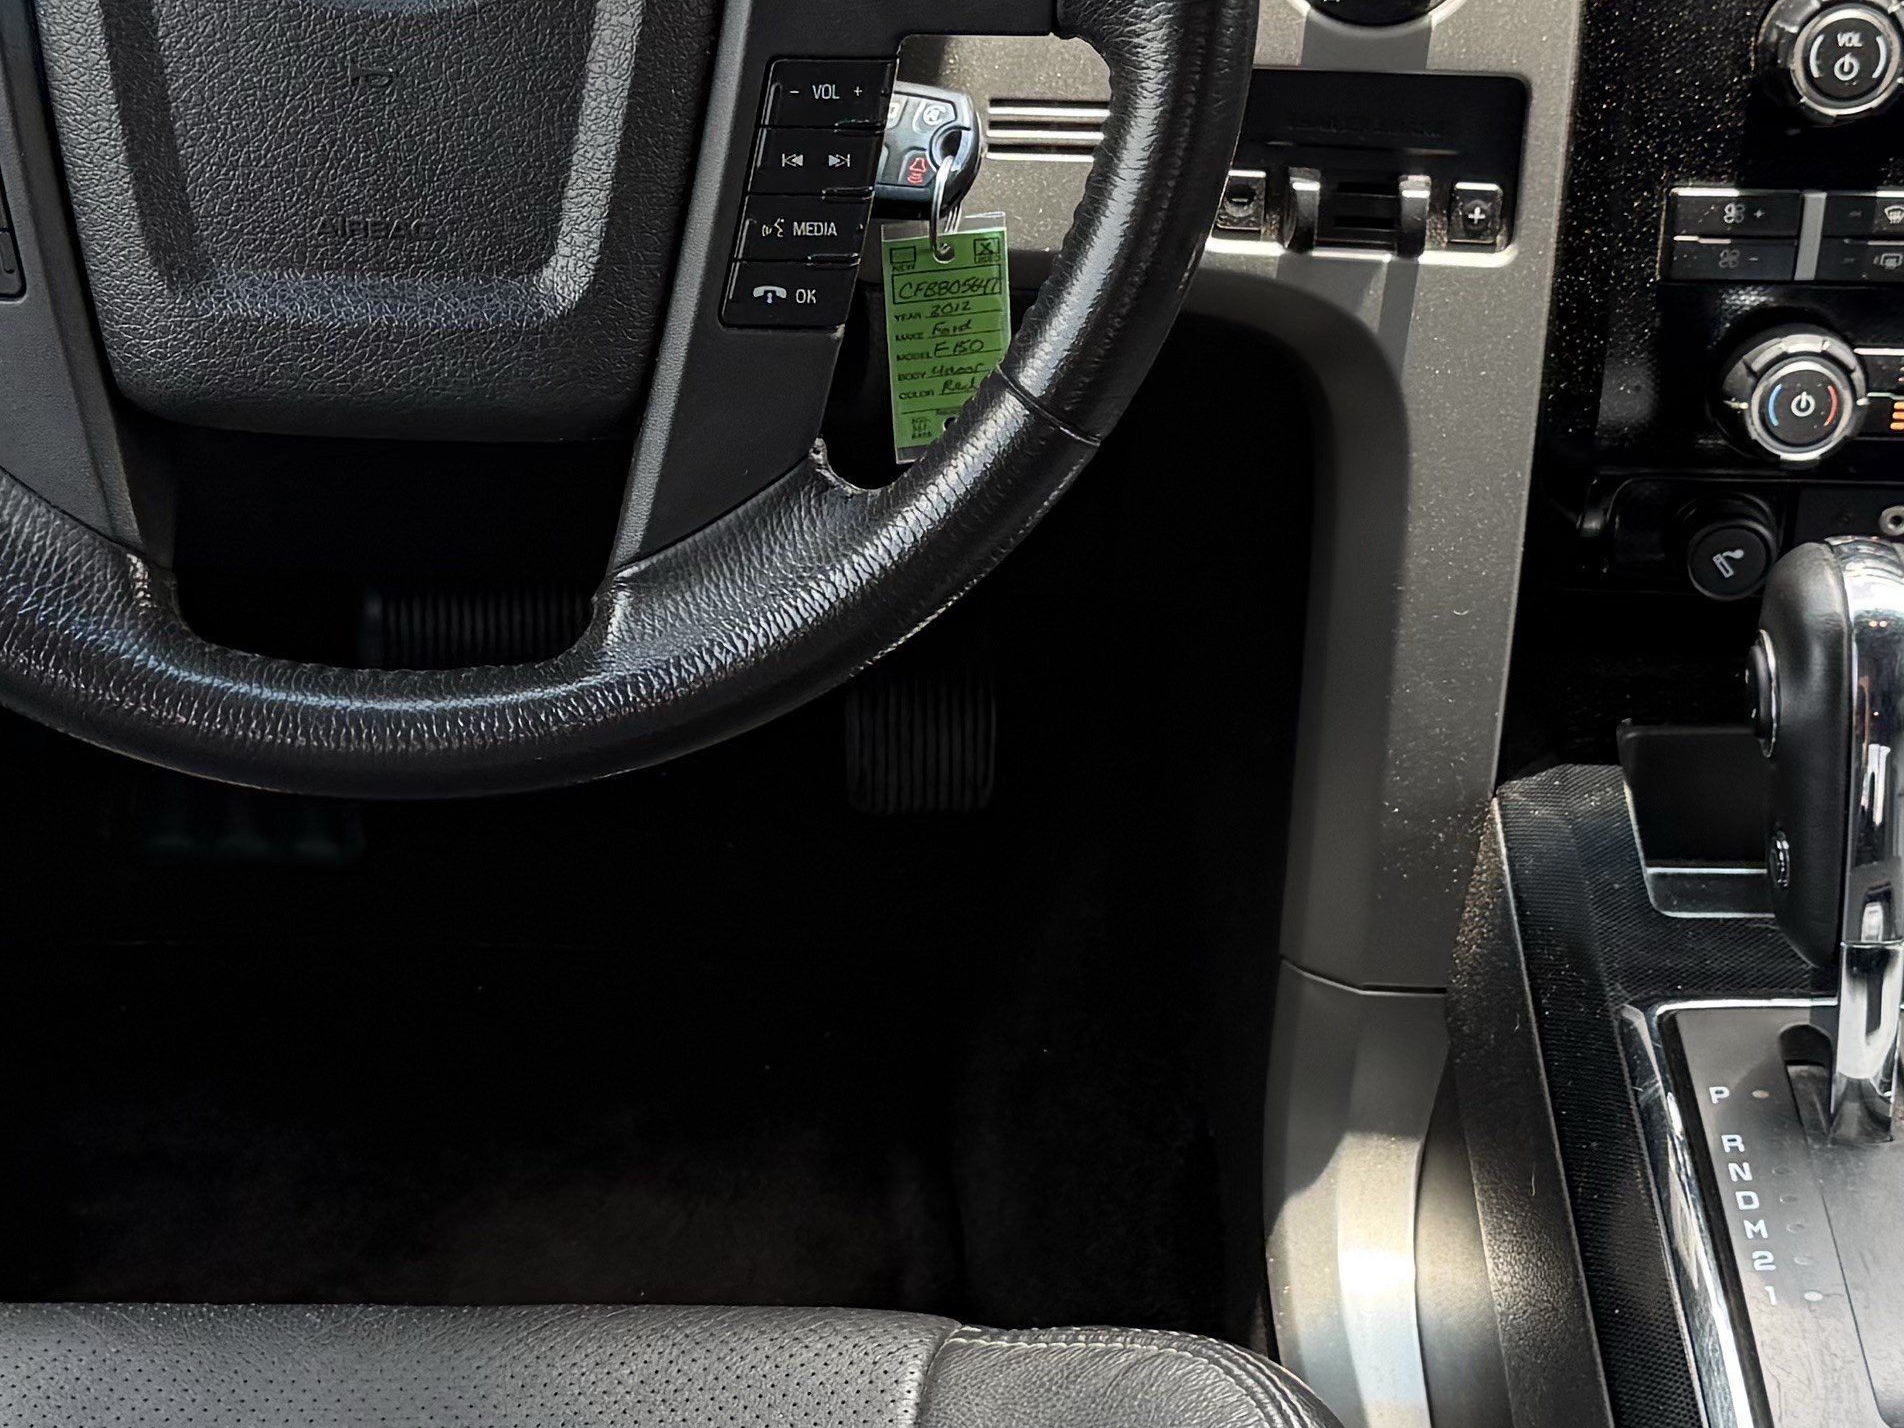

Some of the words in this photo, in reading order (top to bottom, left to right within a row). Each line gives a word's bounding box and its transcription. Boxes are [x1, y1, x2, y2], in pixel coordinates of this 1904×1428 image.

[1837, 31, 1863, 49] VOL
[812, 83, 840, 100] VOL
[793, 221, 837, 237] MEDIA
[796, 288, 817, 304] OK
[931, 300, 971, 318] 2012
[932, 319, 972, 335] Ford
[1709, 1086, 1730, 1104] P
[1721, 1135, 1746, 1152] R
[1728, 1163, 1753, 1182] N
[1735, 1191, 1760, 1210] D
[1743, 1219, 1768, 1239] M
[1751, 1251, 1777, 1272] 2
[1765, 1286, 1778, 1305] 1
